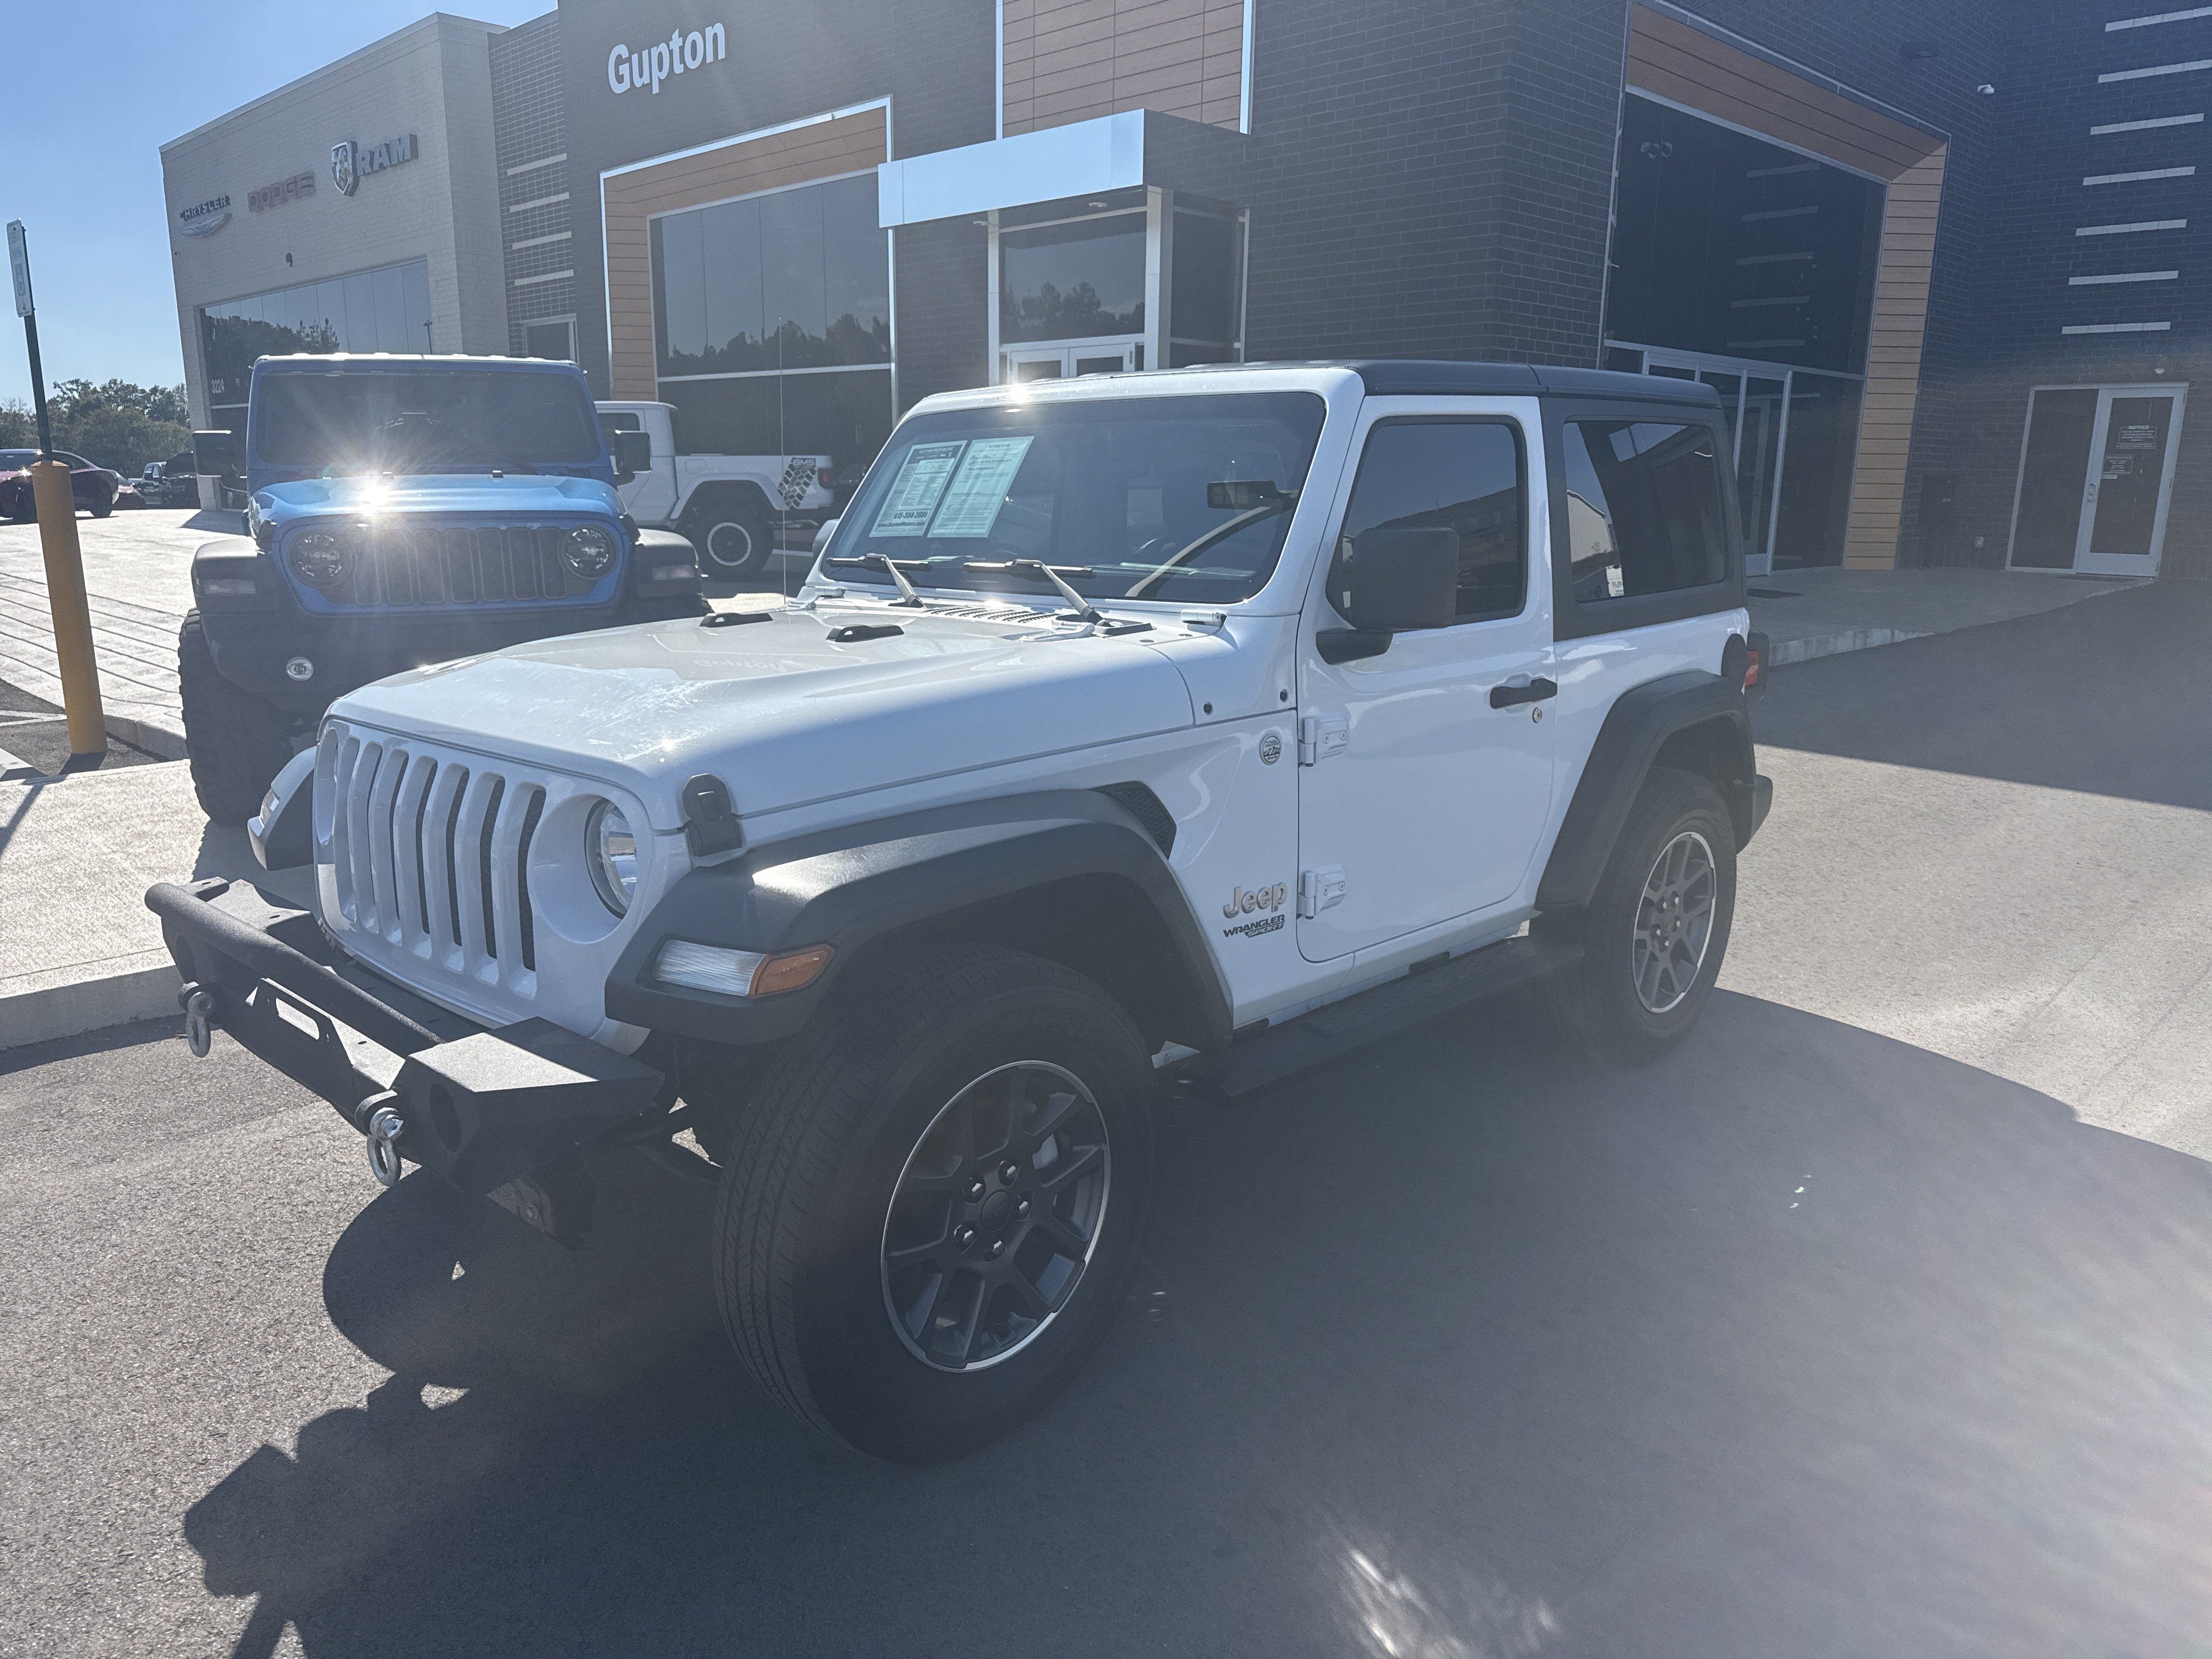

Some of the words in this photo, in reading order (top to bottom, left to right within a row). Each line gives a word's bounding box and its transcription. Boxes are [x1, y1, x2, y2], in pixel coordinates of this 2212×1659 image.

[608, 22, 726, 94] Gupton
[356, 134, 418, 176] RAM
[247, 171, 315, 213] DODGE
[179, 195, 230, 221] CHRYSLER
[211, 379, 224, 394] 3224
[1223, 882, 1288, 918] Jeep
[1223, 914, 1285, 937] WRANGLER
[1246, 923, 1284, 936] SPORT
